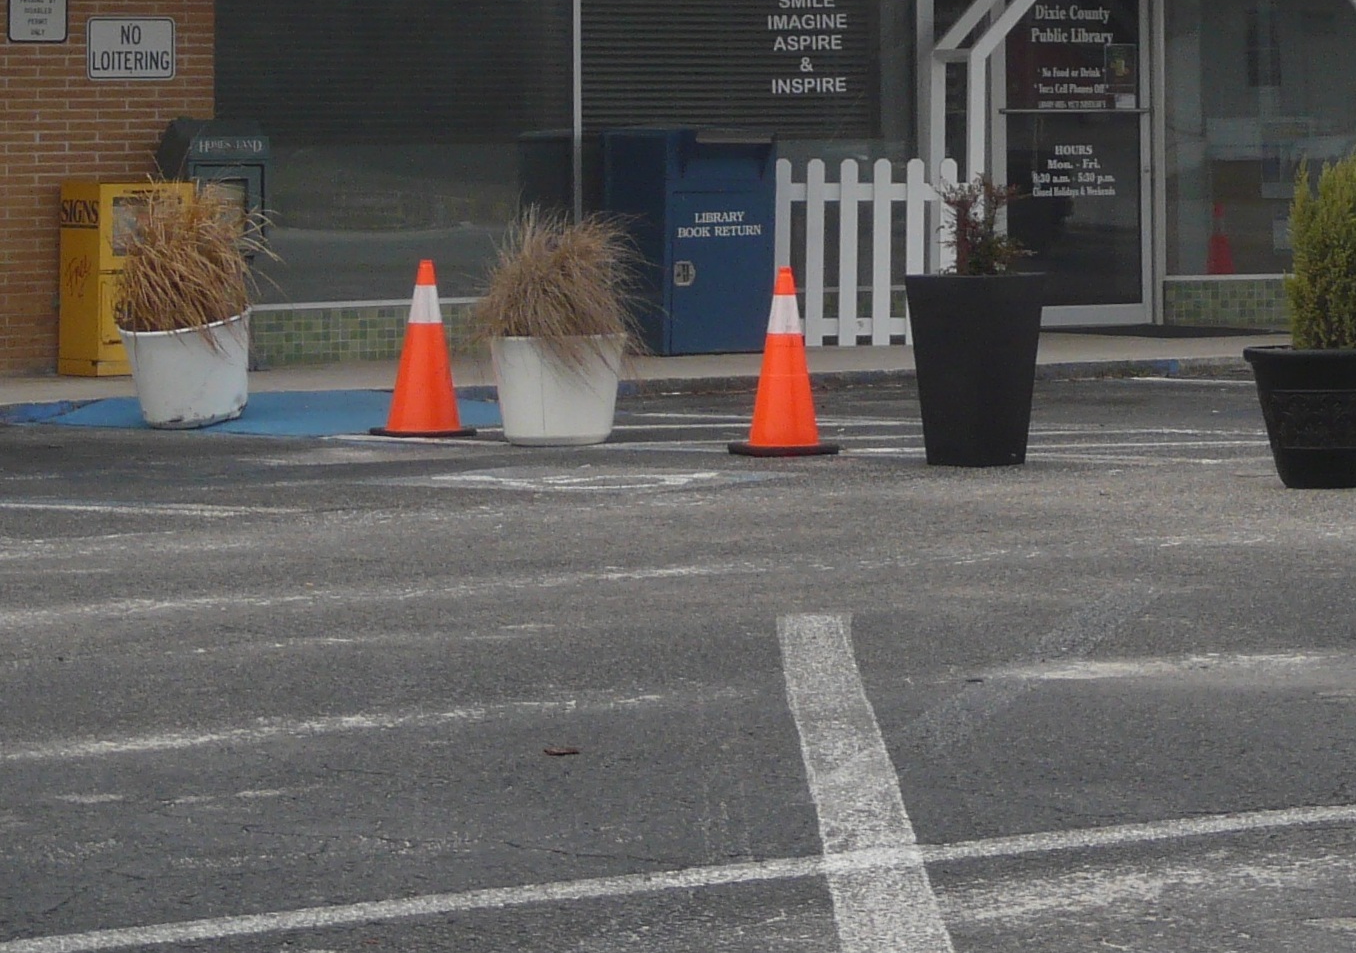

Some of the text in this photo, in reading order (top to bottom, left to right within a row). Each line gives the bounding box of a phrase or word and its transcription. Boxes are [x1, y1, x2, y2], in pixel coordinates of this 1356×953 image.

[767, 13, 848, 30] IMAGINE
[1034, 4, 1110, 24] Dixie County
[120, 24, 142, 46] NO
[773, 34, 843, 51] ASPIRE
[1031, 27, 1114, 45] Public Library
[92, 50, 171, 71] LOITERING
[799, 56, 814, 72] &
[771, 77, 847, 94] INSPIRE
[1054, 83, 1068, 94] Cell
[1054, 145, 1093, 155] HOURS
[1047, 159, 1074, 169] Mon.
[1081, 158, 1101, 169] Fri.
[1097, 174, 1116, 185] p.m.
[61, 199, 99, 224] SIGNS
[695, 211, 745, 223] LIBRARY
[677, 224, 762, 238] BOOK RETURN
